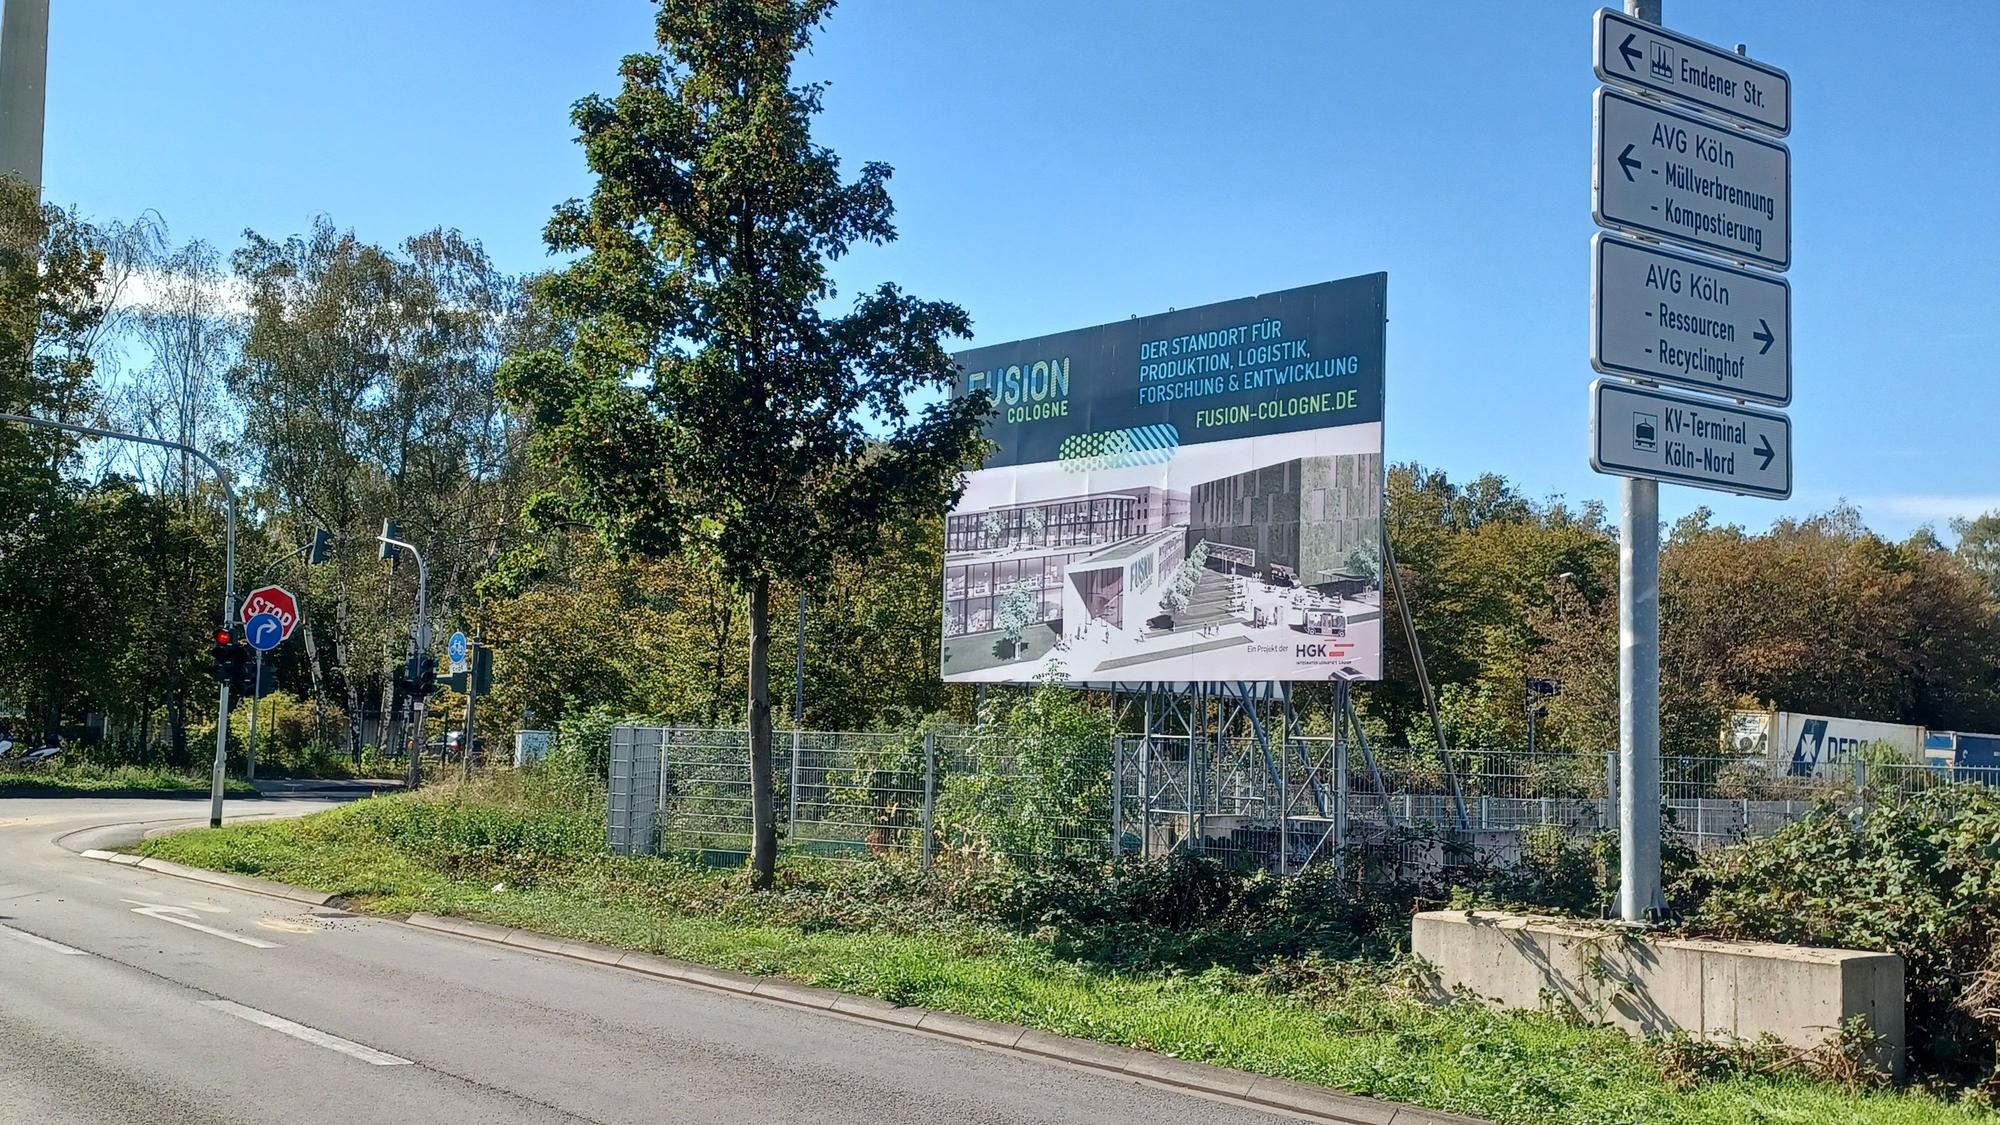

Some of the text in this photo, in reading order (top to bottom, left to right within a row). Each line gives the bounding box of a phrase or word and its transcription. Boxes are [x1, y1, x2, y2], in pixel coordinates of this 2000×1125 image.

[1680, 57, 1765, 109] Emdener Str.
[1651, 122, 1735, 169] AVG Köln
[1665, 161, 1774, 221] Müllverbrennung
[1665, 197, 1762, 251] Kompostierung
[1645, 263, 1729, 306] AVG Köln
[1141, 318, 1282, 360] DER STANDORT FÜR
[1659, 302, 1735, 342] Ressourcen
[1139, 356, 1358, 405] FORSCHUNG & ENTWICKLUNG
[1140, 339, 1311, 382] PRODUKTION, LOGISTIK,
[1659, 339, 1745, 381] Recyclinghof
[967, 357, 1070, 408] FUSION
[1007, 400, 1069, 424] COLOGNE
[1196, 389, 1358, 428] FUSION-COLOGNE.DE
[1665, 407, 1747, 445] KV-Terminal
[1665, 440, 1735, 475] Köln-Nord
[247, 596, 292, 626] STOP
[1296, 644, 1327, 658] HGK
